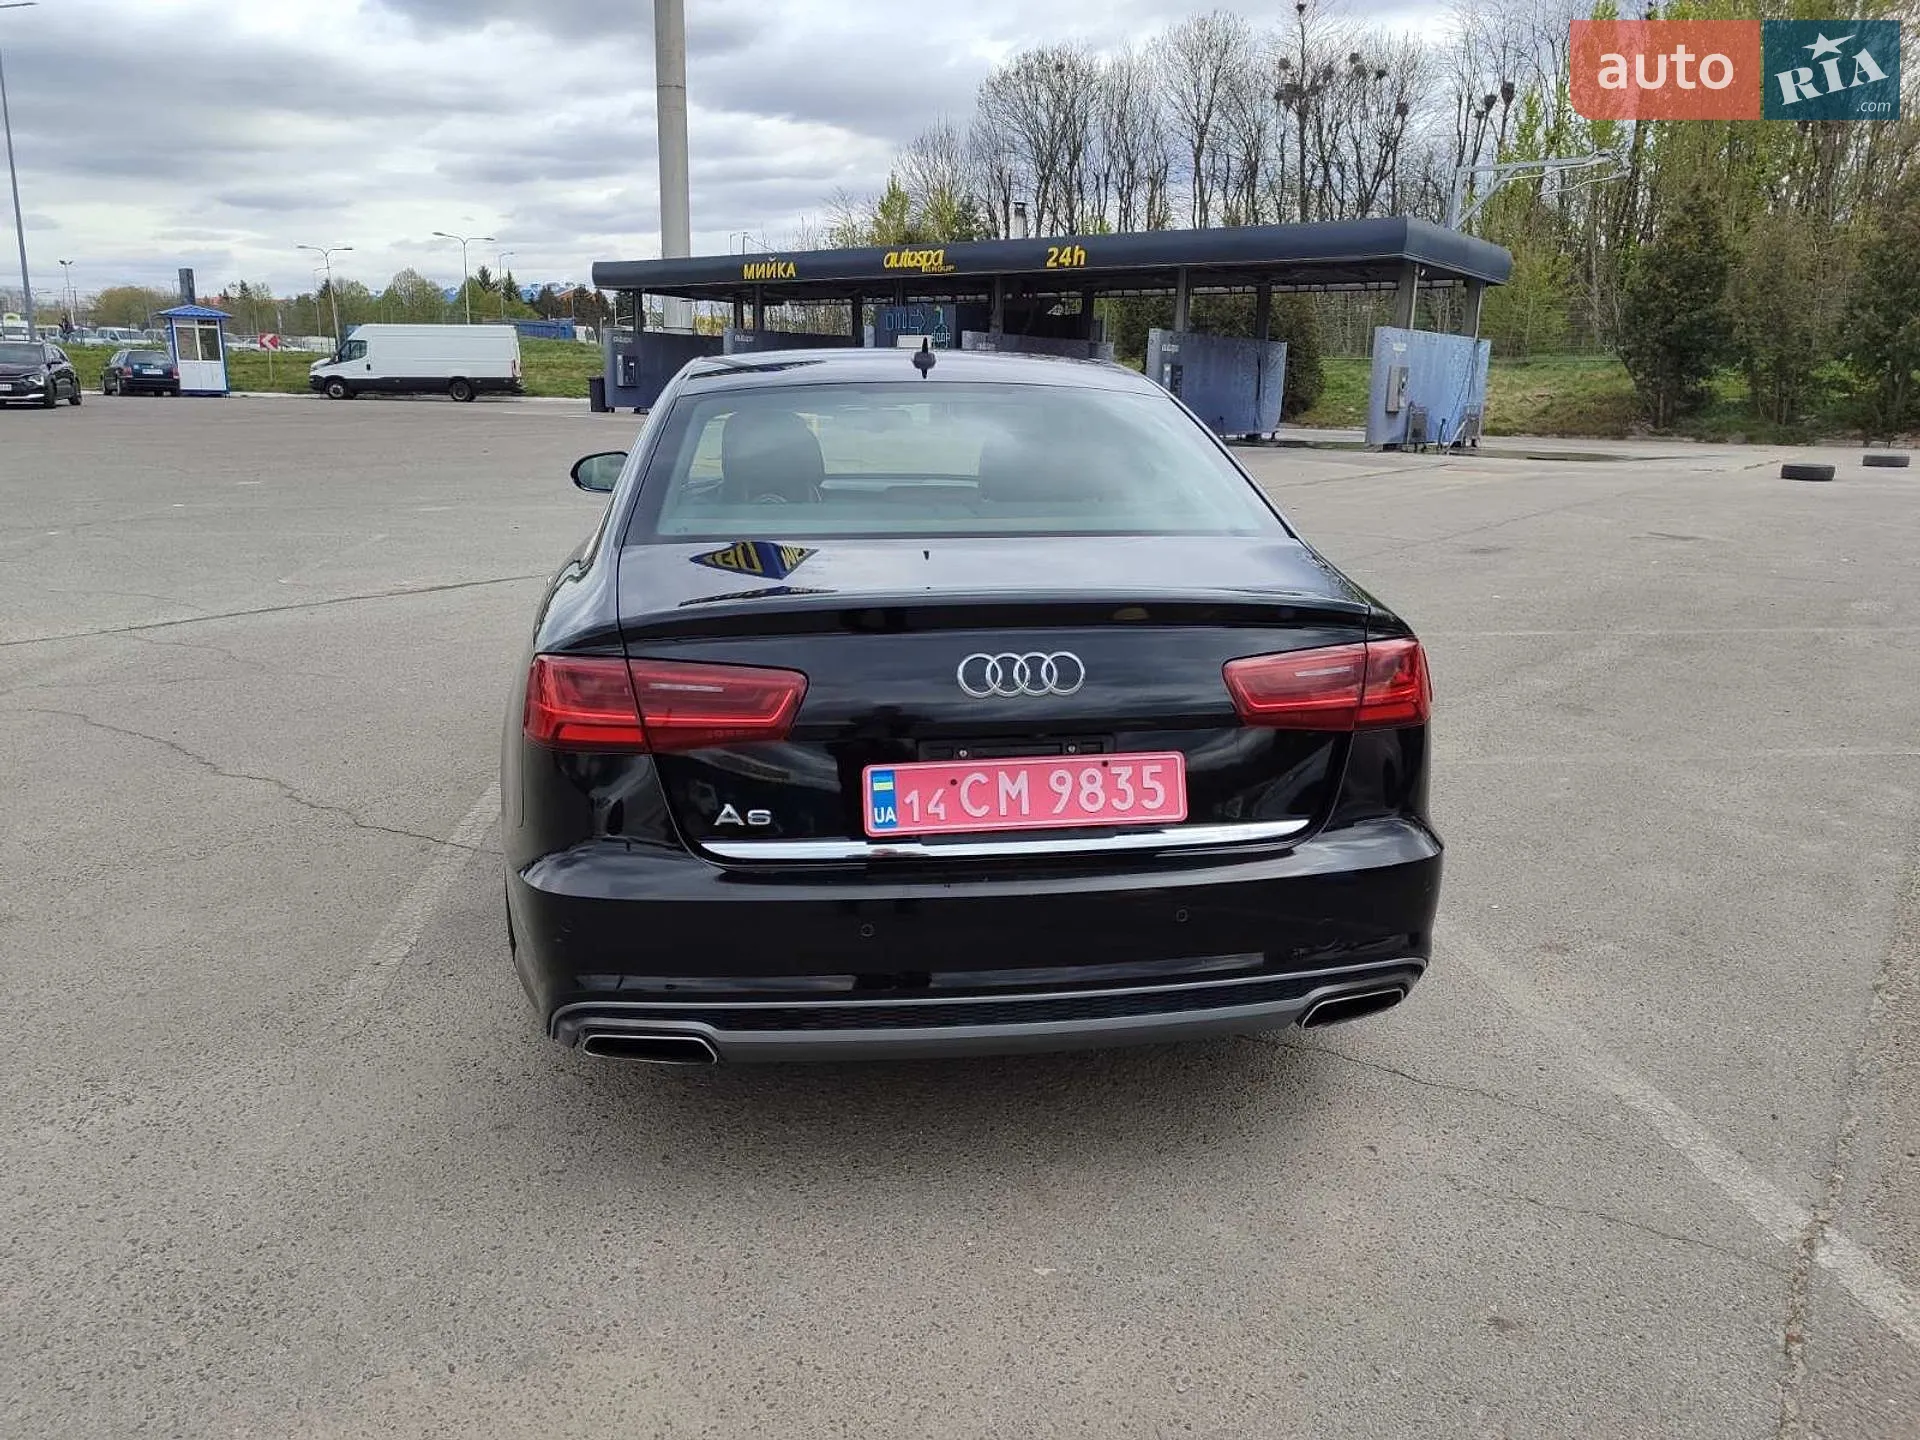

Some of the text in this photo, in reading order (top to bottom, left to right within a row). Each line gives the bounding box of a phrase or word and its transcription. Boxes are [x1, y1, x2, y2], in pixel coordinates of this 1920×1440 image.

[743, 256, 796, 280] МИЙКА
[883, 248, 944, 272] autospa
[1046, 245, 1086, 268] 24h
[904, 764, 1169, 822] 14 CM 9835
[713, 803, 772, 826] A6
[873, 807, 897, 824] UA
